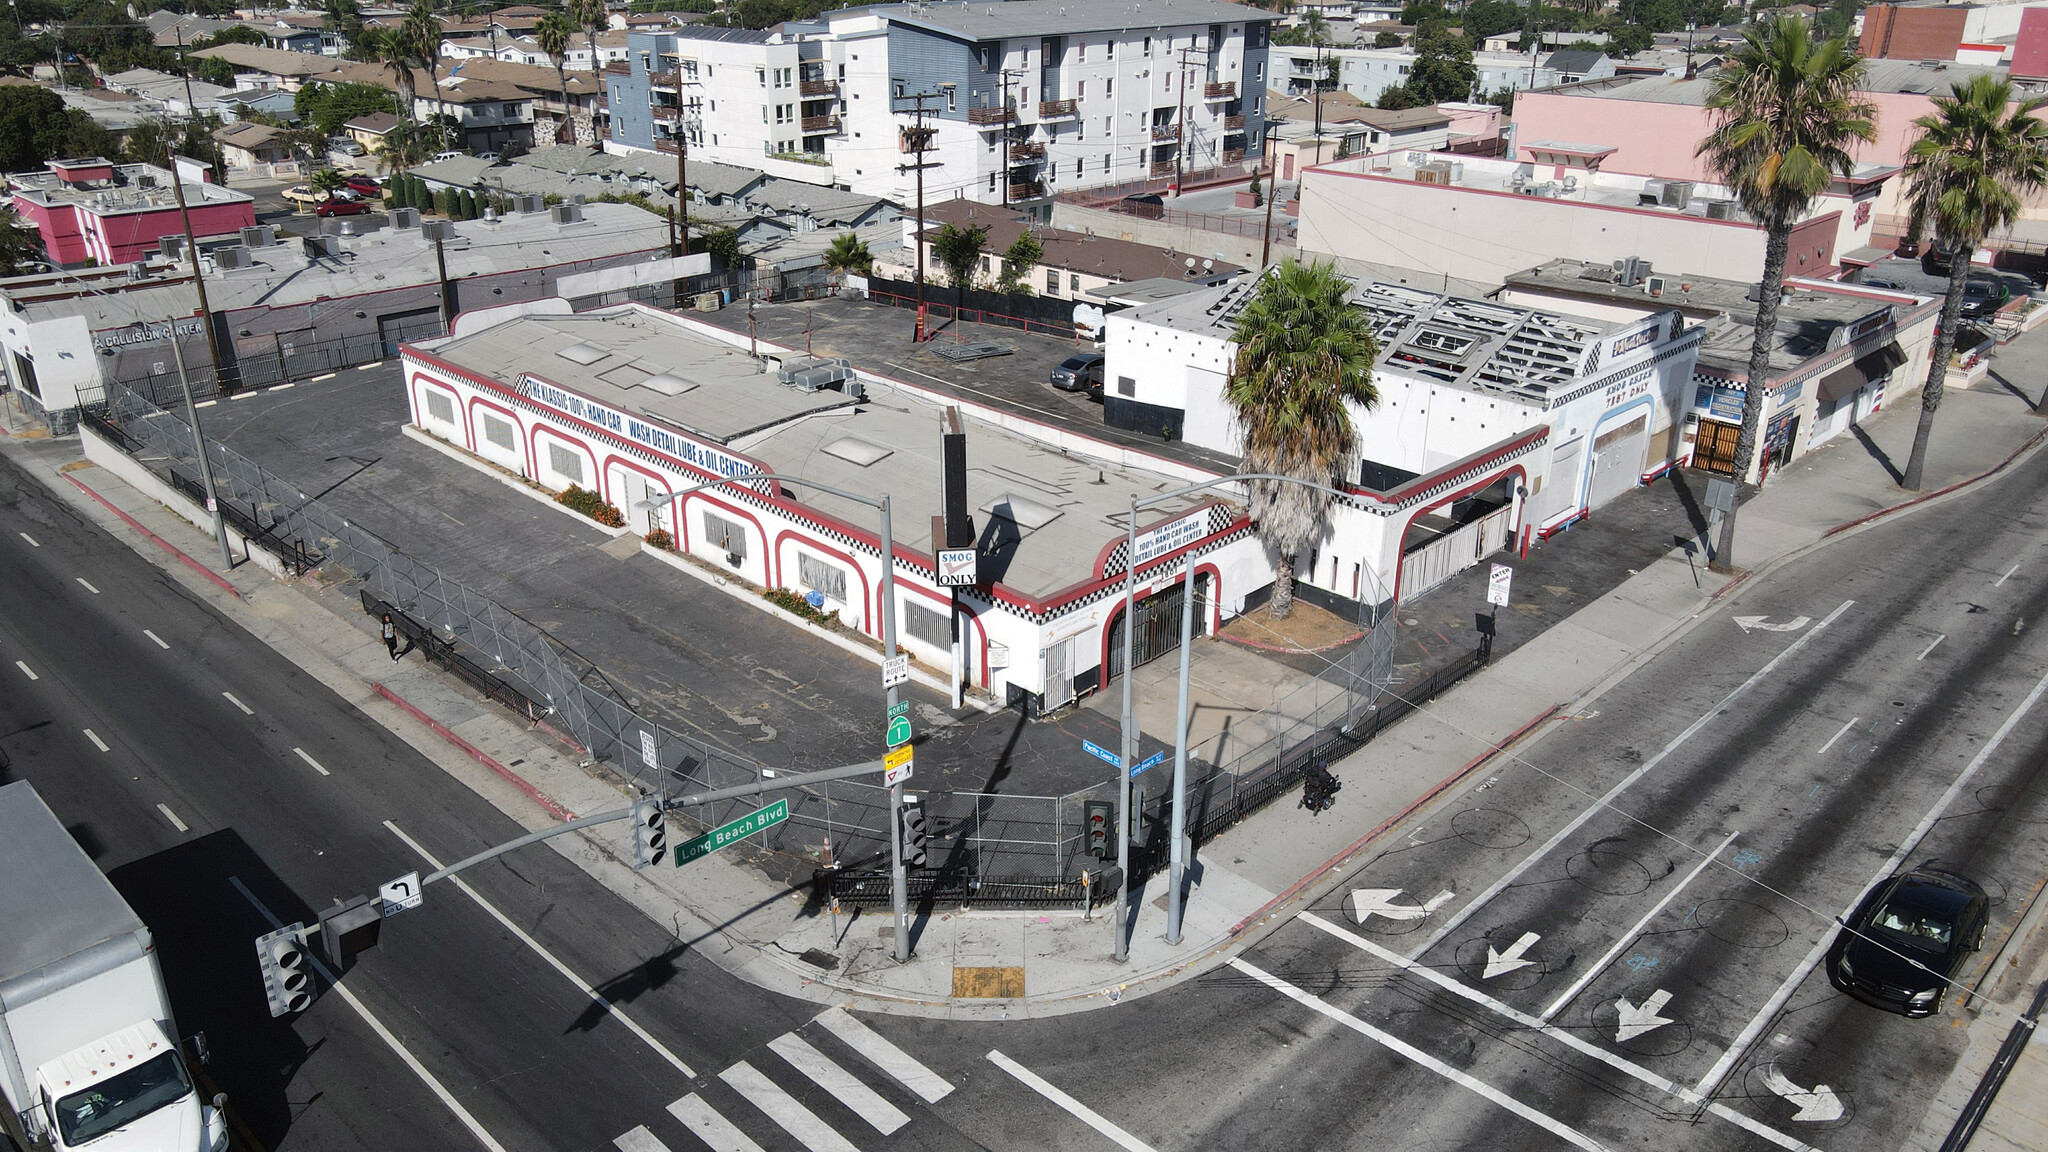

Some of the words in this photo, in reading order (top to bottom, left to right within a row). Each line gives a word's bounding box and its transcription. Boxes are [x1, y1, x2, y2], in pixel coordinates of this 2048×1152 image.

[105, 330, 160, 347] COLLISION
[162, 323, 202, 338] CNTER
[1606, 381, 1626, 396] SMOG
[1606, 392, 1626, 408] TEST
[1630, 381, 1649, 397] ONLY
[527, 379, 541, 399] THE
[541, 384, 568, 411] KLASSIC
[568, 396, 588, 418] 100%
[587, 403, 606, 426] HAND
[607, 411, 622, 432] CAR
[628, 419, 651, 444] WASH
[652, 428, 677, 455] DETAIL
[678, 438, 697, 462] LUBE
[698, 450, 705, 465] &
[705, 450, 718, 471] OIL
[719, 455, 750, 483] CENTER
[1153, 527, 1163, 536] THE
[1164, 518, 1187, 531] KLASSIC
[1139, 539, 1154, 552] 100%
[1155, 532, 1170, 544] HAND
[1171, 527, 1183, 539] CAR
[1183, 520, 1200, 533] WASH
[1134, 551, 1153, 564] DETAIL
[1153, 544, 1168, 556] LUBE
[1168, 542, 1173, 550] &
[1173, 537, 1182, 547] OIL
[1182, 528, 1203, 544] CENTER
[942, 552, 973, 562] SMOG
[940, 574, 977, 585] ONLY
[1491, 567, 1511, 579] ENTER
[885, 657, 906, 669] TRUCK
[886, 666, 906, 677] ROUTE
[888, 703, 908, 717] NORTH
[896, 727, 901, 740] 1
[1084, 743, 1099, 755] Pacific
[1100, 751, 1113, 762] Coast
[1130, 766, 1141, 776] Long
[1141, 760, 1154, 770] Beach
[681, 840, 712, 860] Long
[716, 821, 753, 845] Beach
[757, 806, 783, 826] Blvd
[396, 903, 403, 911] U
[404, 897, 420, 906] TURN
